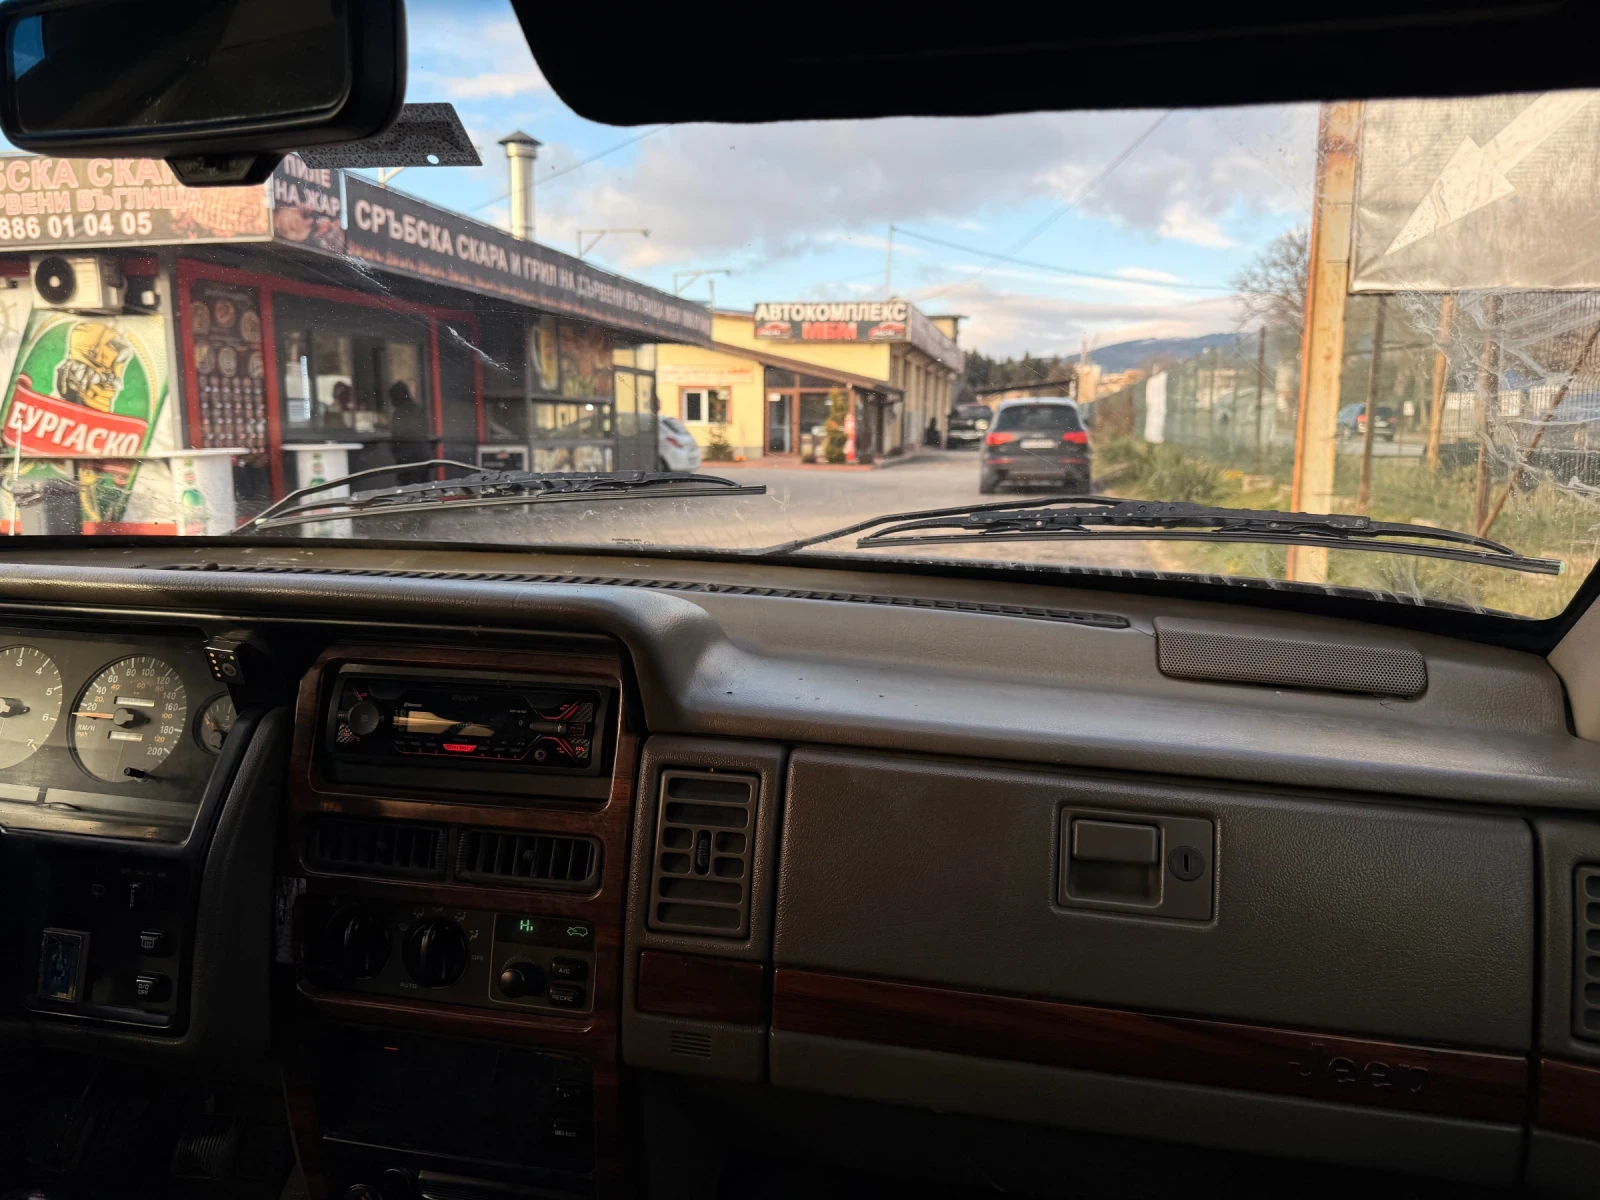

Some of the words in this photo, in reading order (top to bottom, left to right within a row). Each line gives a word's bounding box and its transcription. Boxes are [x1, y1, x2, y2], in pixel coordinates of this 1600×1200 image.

[274, 178, 301, 206] НА
[304, 187, 341, 217] ЖАР
[47, 214, 76, 239] 01
[83, 212, 115, 237] 04
[121, 211, 153, 236] 05
[354, 199, 455, 257] СРЪБСКА
[455, 233, 510, 273] СКАРА
[509, 252, 521, 277] И
[558, 267, 575, 292] НА
[756, 303, 906, 321] АВТОКОМПЛЕКС
[16, 659, 23, 667] 3
[35, 667, 42, 676] 4
[126, 668, 136, 677] 80
[141, 668, 155, 677] 100
[108, 675, 118, 683] 60
[157, 676, 170, 685] 120
[45, 687, 53, 696] 5
[96, 686, 106, 695] 40
[163, 692, 176, 700] 140
[87, 702, 97, 711] 20
[165, 703, 178, 711] 160
[42, 713, 49, 721] 6
[77, 724, 95, 732] KM/H
[160, 726, 173, 734] 180
[27, 738, 34, 747] 7
[147, 747, 163, 756] 200
[558, 967, 571, 975] A/C
[399, 981, 418, 989] AUTO
[1287, 1042, 1430, 1093] Jeep
